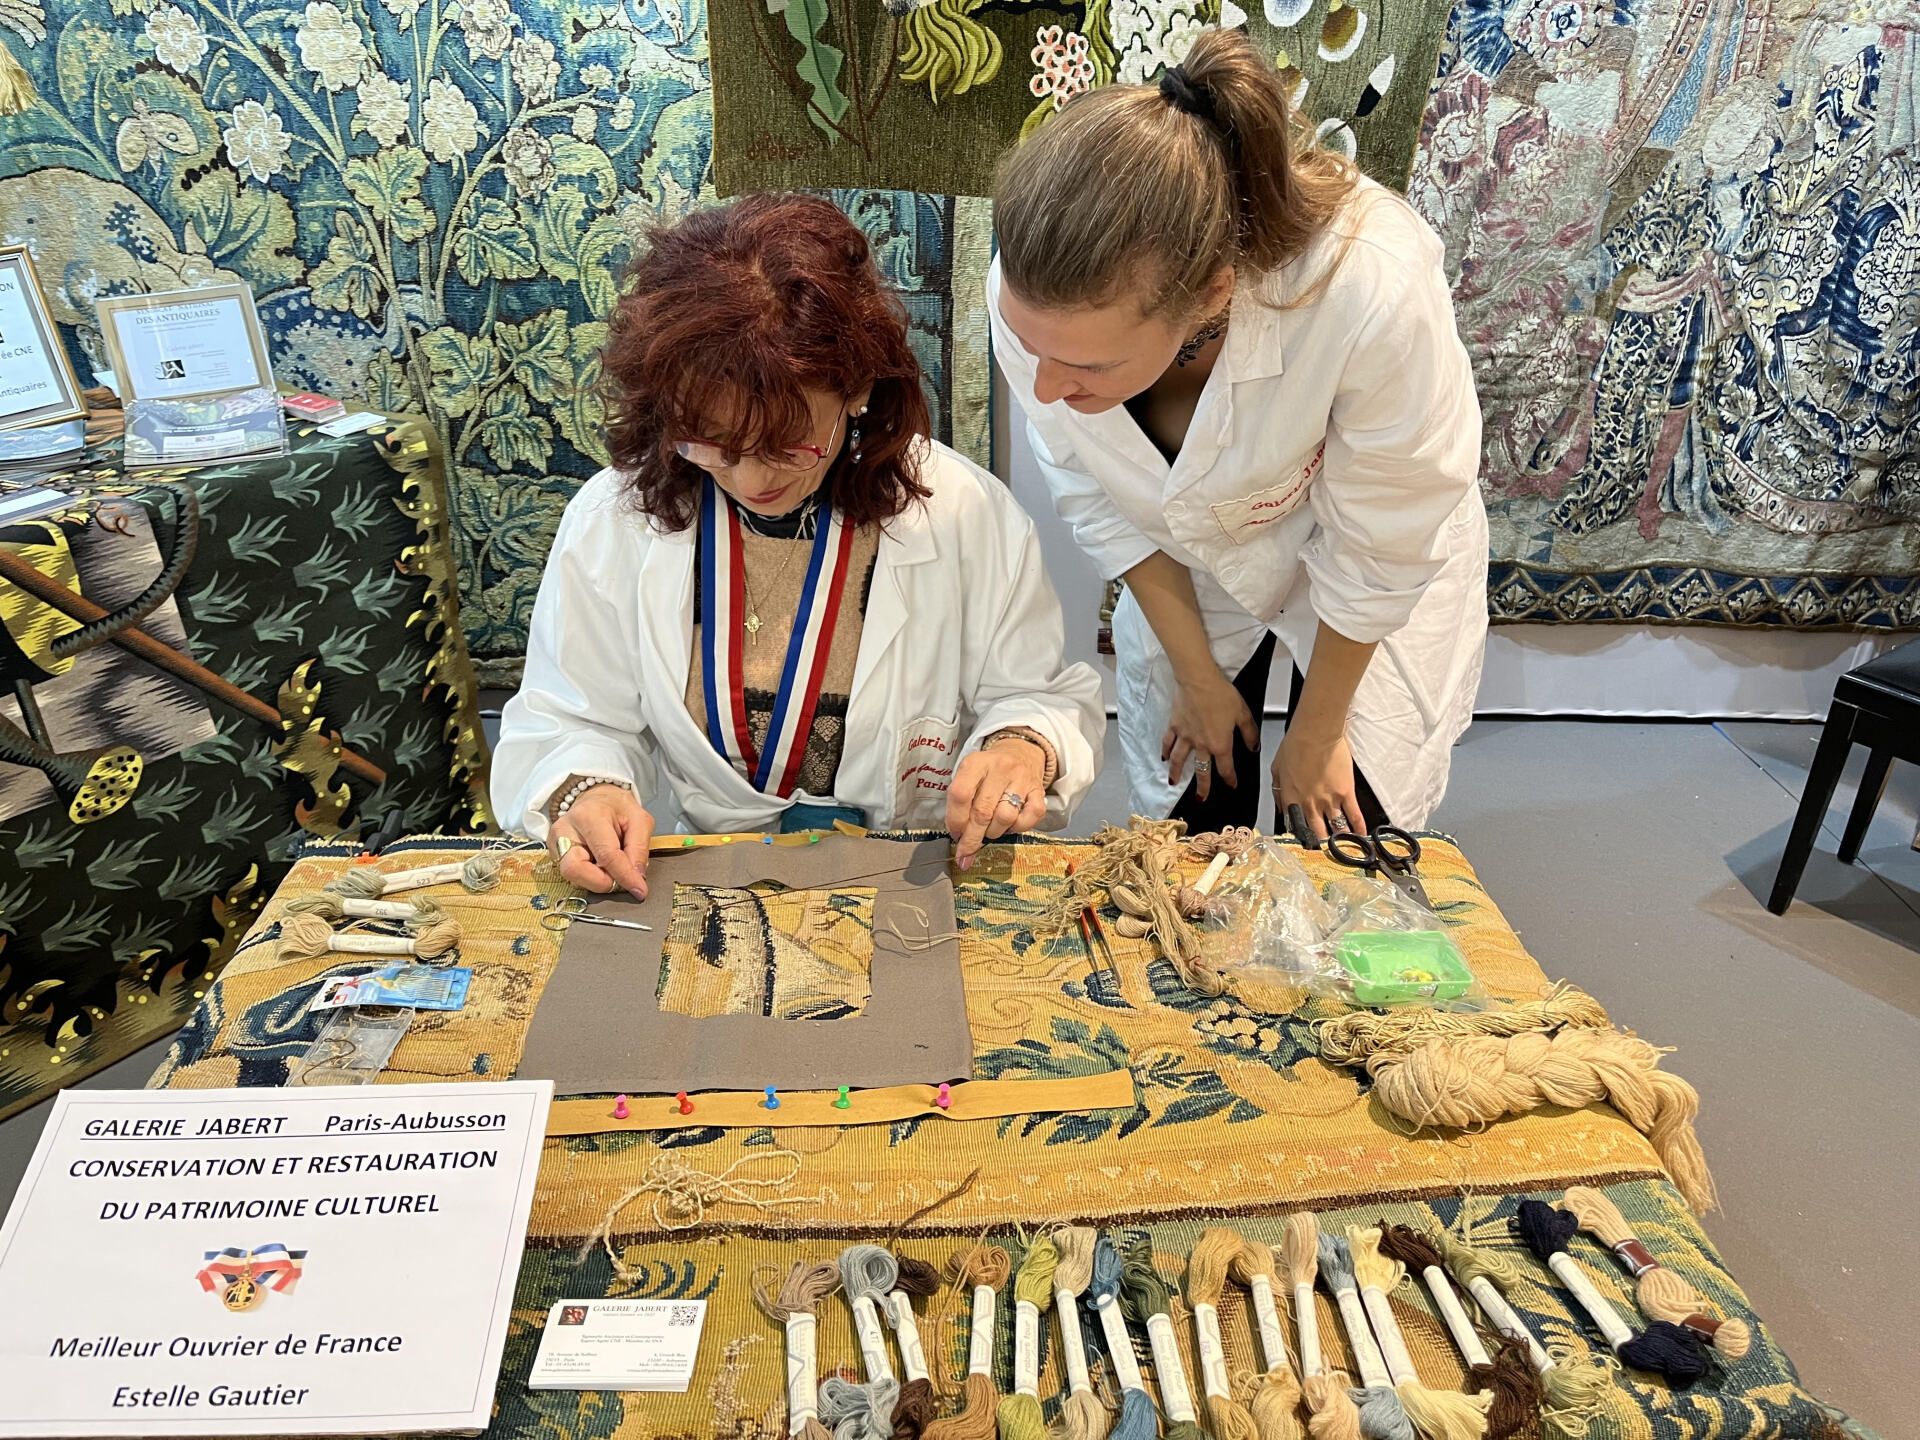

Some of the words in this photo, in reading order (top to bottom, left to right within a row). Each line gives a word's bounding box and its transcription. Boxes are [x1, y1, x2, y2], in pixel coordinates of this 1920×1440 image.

[136, 316, 154, 325] DES
[156, 308, 220, 322] ANTIQUAIRES
[14, 345, 34, 357] CNE
[916, 778, 949, 791] Paris
[416, 877, 431, 887] 523
[85, 1119, 186, 1136] GALERIE
[195, 1117, 288, 1136] JABERT
[325, 1112, 506, 1132] Paris-Aubusson
[69, 1158, 266, 1177] CONSERVATION
[271, 1157, 303, 1175] ET
[307, 1150, 498, 1174] RESTAURATION
[99, 1202, 139, 1220] DU
[144, 1198, 308, 1220] PATRIMOINE
[315, 1194, 439, 1216] CULTUREL
[49, 1336, 163, 1358] Meilleur
[168, 1336, 268, 1357] Ouvrier
[274, 1333, 307, 1355] de
[314, 1333, 403, 1354] France
[112, 1385, 200, 1407] Estelle
[208, 1384, 309, 1407] Gautier
